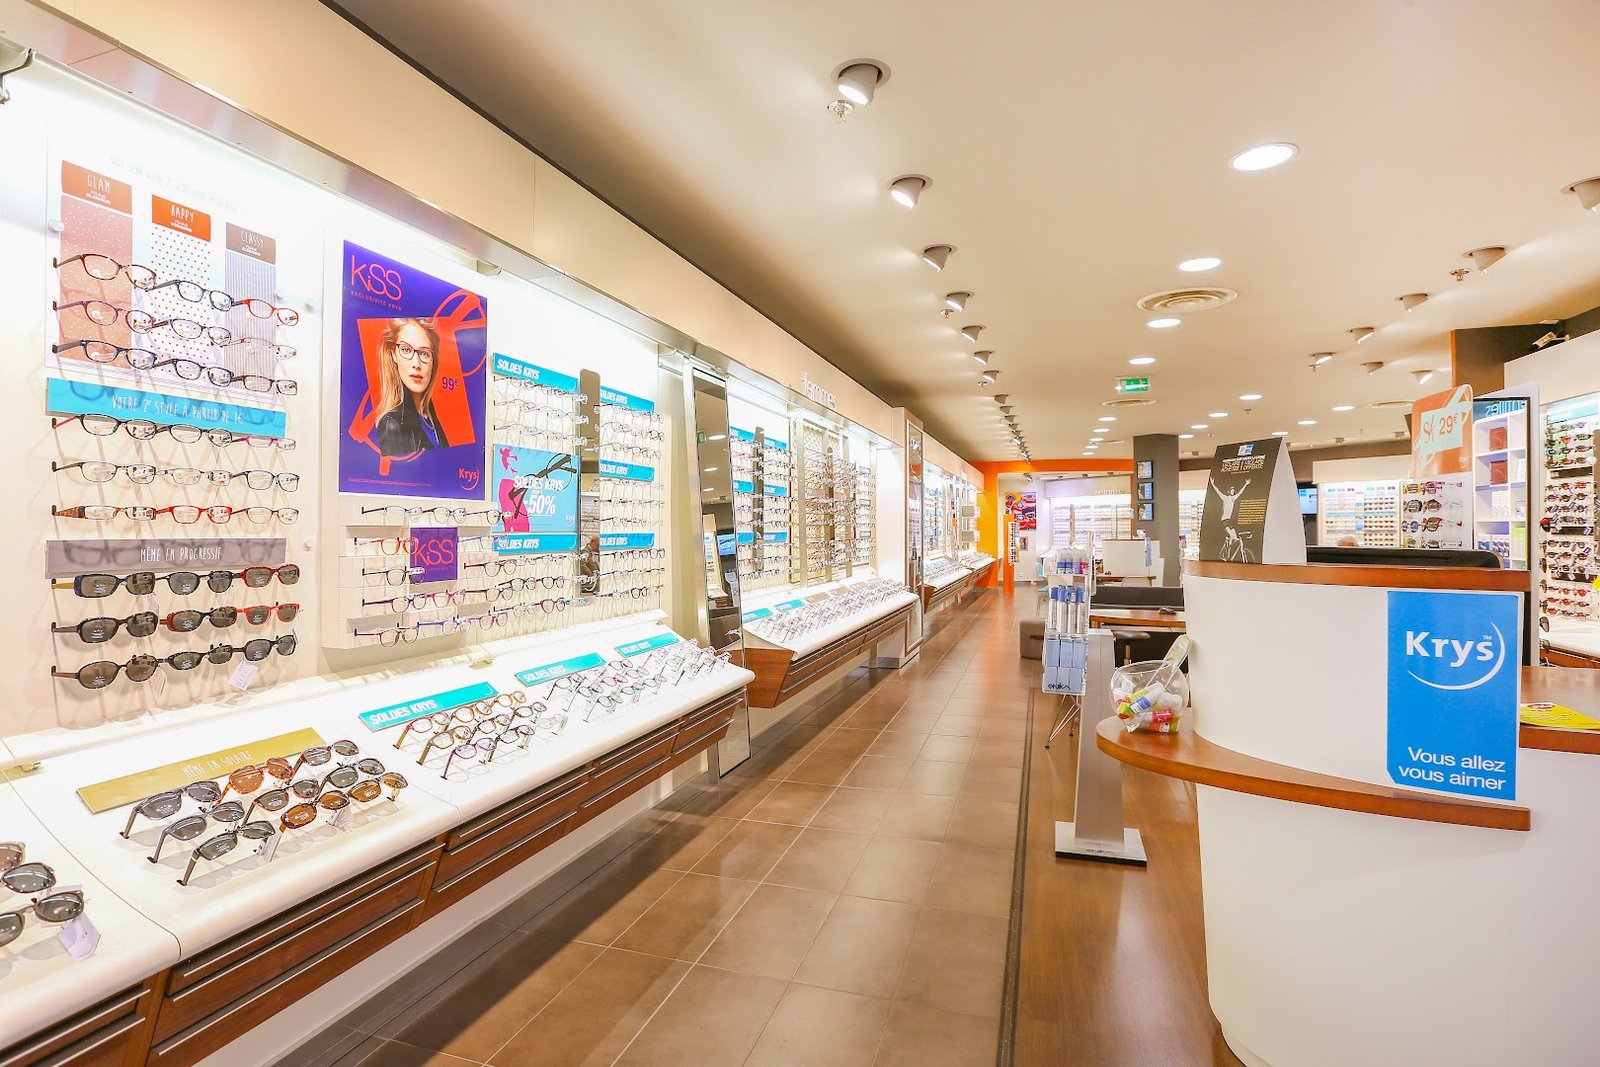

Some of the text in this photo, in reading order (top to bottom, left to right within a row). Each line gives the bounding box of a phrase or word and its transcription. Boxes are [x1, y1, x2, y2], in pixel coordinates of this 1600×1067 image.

[87, 174, 111, 193] GLAM
[240, 230, 264, 248] CLASSY
[496, 358, 540, 380] SOLDES KRYS
[112, 394, 138, 412] VOTRE
[154, 400, 179, 417] STYLE
[459, 467, 478, 482] Krys
[513, 475, 565, 492] SOLDES KRYS
[522, 538, 540, 549] KRYS
[139, 546, 223, 562] MÊME EN PROGRESSIF
[1405, 630, 1494, 668] Krys
[369, 699, 438, 725] SOLDES KRYS
[1407, 746, 1506, 773] Vous allez
[1398, 766, 1506, 791] vous aimer
